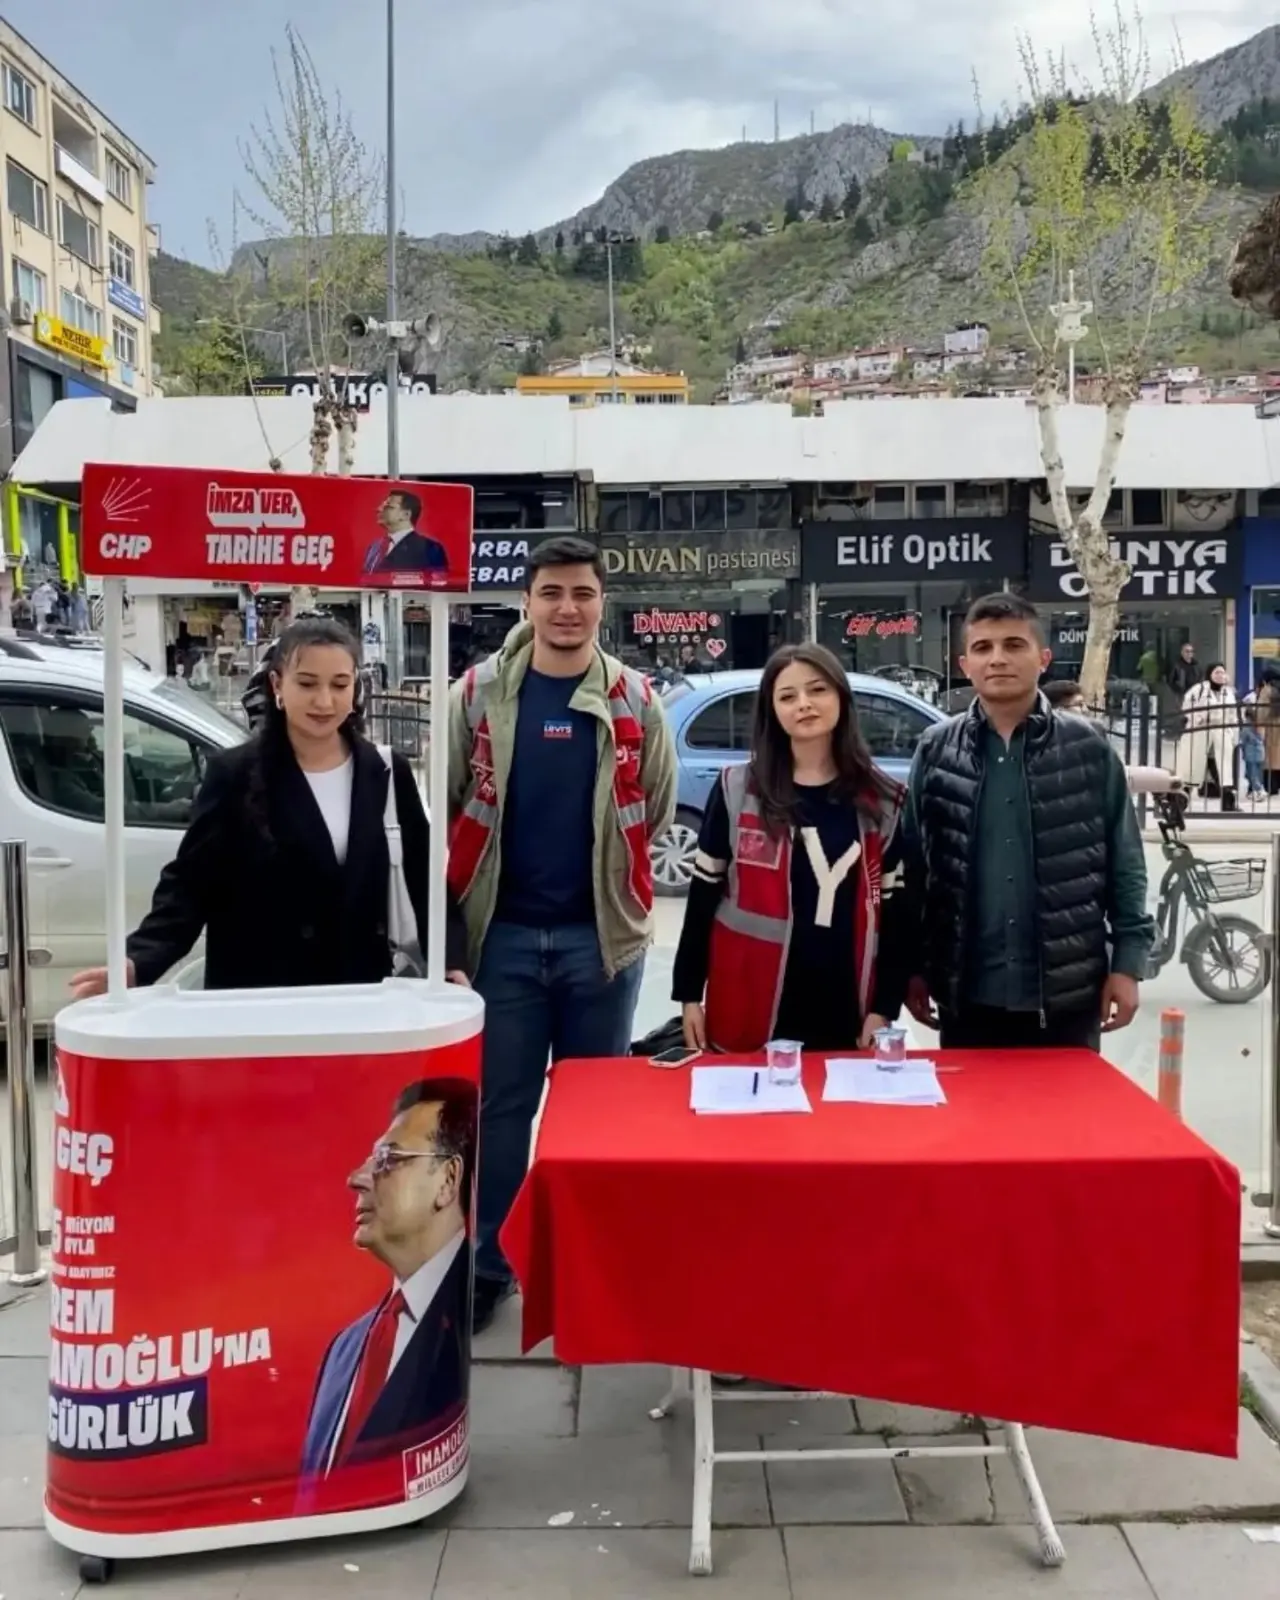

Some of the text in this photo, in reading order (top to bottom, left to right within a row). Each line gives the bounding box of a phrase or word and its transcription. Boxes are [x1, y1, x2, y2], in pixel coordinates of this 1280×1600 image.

[209, 484, 297, 518] İMZA VER,
[100, 533, 152, 560] CHP
[291, 534, 334, 572] GEÇ
[471, 540, 529, 558] RBA
[603, 540, 797, 575] DİVAN pastanesi
[836, 532, 993, 569] Elif Optik
[633, 607, 708, 634] DİVAN
[800, 826, 862, 928] Y
[56, 1126, 114, 1187] GEÇ
[65, 1215, 116, 1235] MİLYON
[64, 1236, 96, 1256] OYLA
